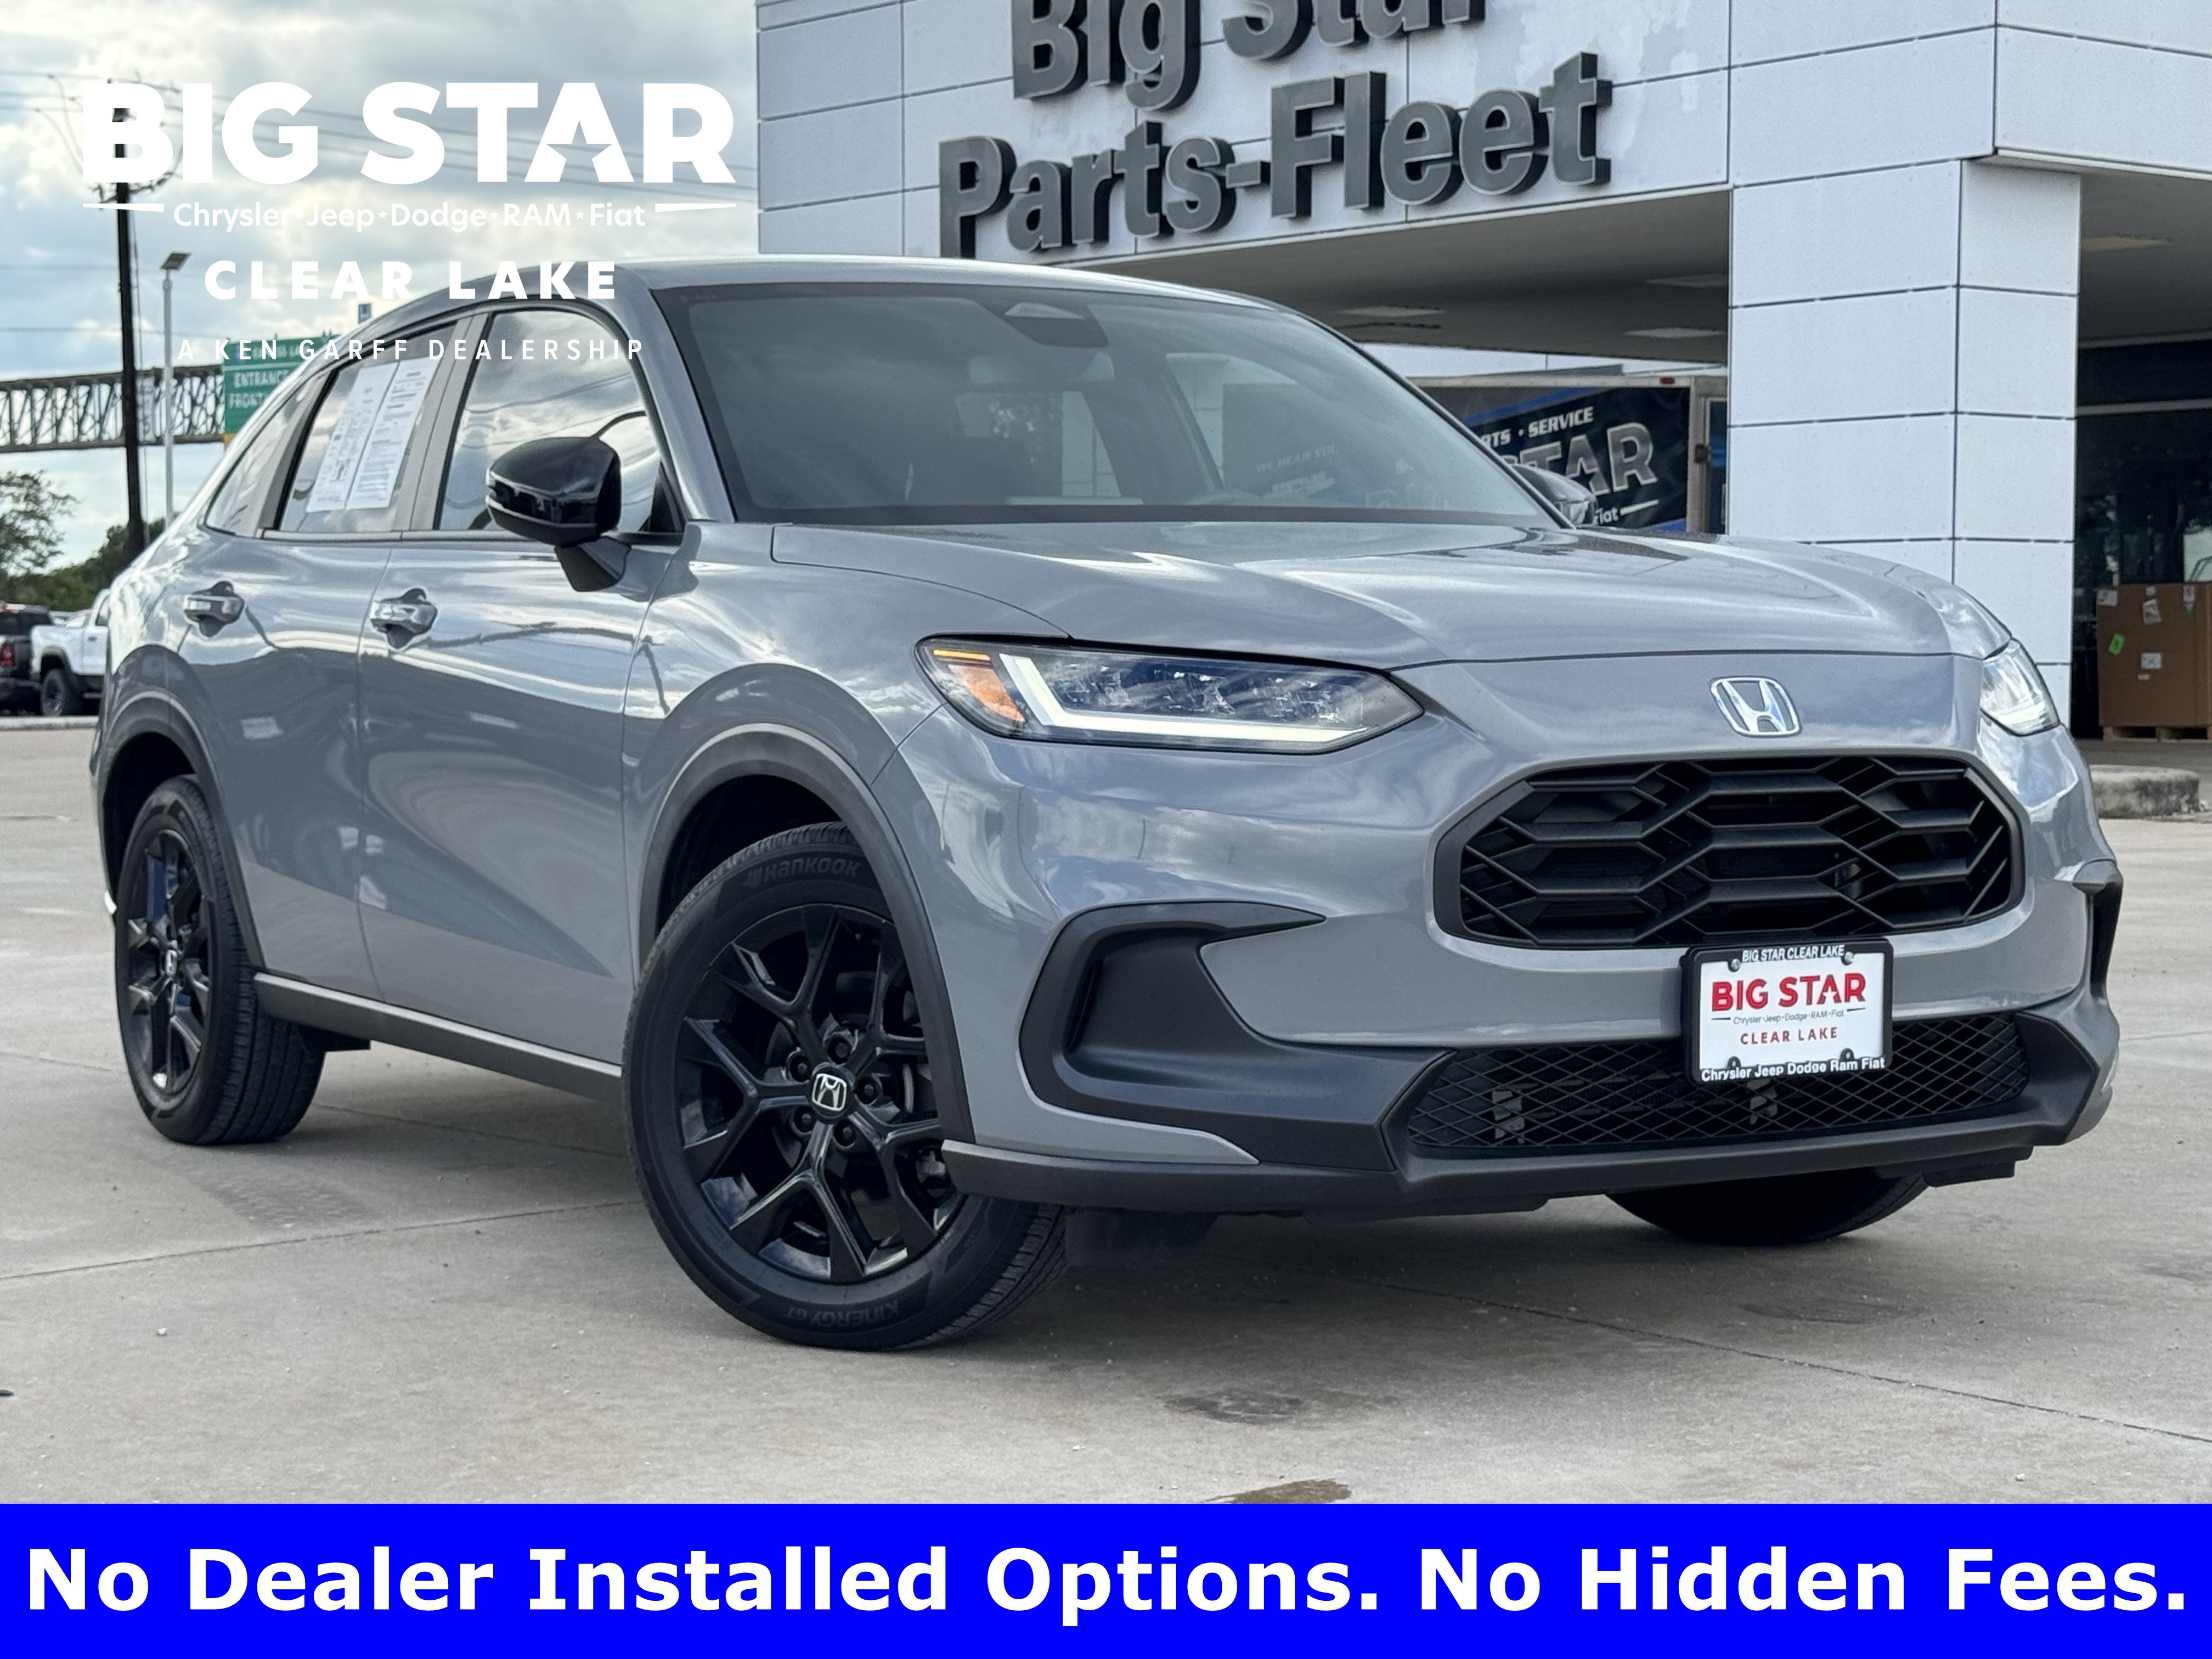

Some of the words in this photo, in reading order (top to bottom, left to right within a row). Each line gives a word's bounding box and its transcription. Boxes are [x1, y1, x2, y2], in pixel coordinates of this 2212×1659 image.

[939, 51, 1609, 258] Parts-Fleet
[1480, 428, 1511, 448] RTS
[1528, 406, 1594, 438] SERVICE
[1499, 422, 1658, 496] TAR
[1742, 949, 1759, 962] BIG
[1760, 947, 1786, 961] STAR
[1787, 946, 1819, 960] CLEAR
[1820, 944, 1846, 957] LAKE
[1712, 979, 1769, 1012] BIG
[1778, 972, 1866, 1008] STAR
[1740, 1030, 1790, 1045] CLEAR
[1798, 1026, 1838, 1041] LAKE
[1701, 1066, 1752, 1082] Chrysler
[1754, 1064, 1784, 1079] Jeep
[1787, 1060, 1827, 1075] Dodge
[1830, 1059, 1858, 1071] Ram
[1861, 1057, 1886, 1070] Fiat
